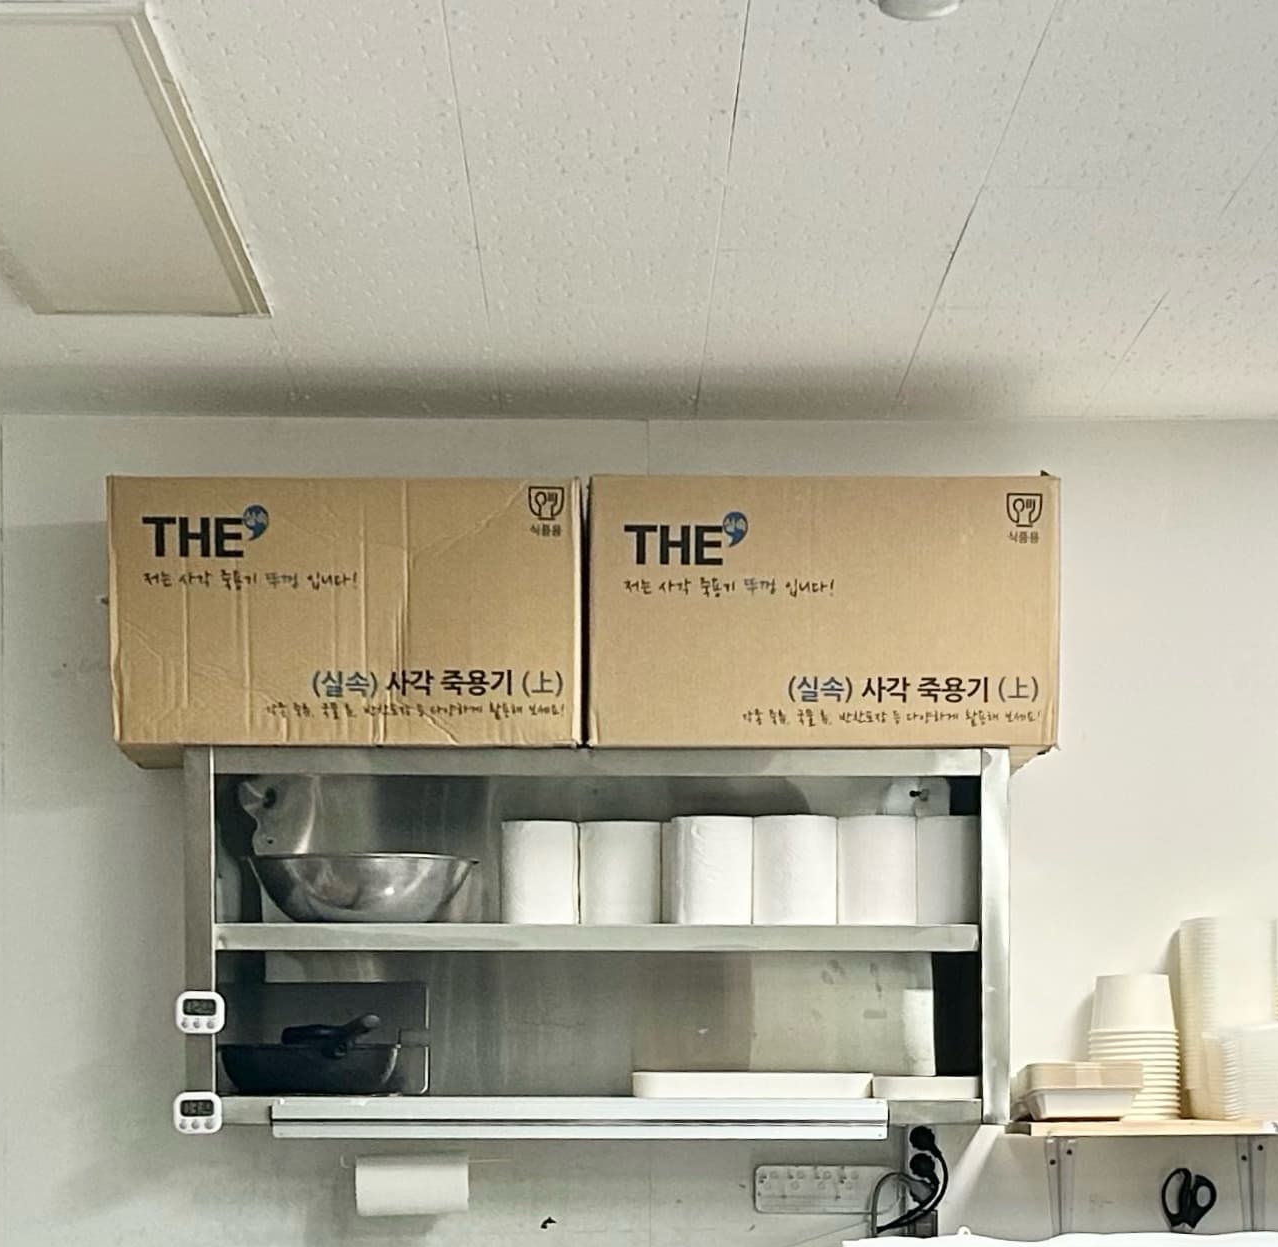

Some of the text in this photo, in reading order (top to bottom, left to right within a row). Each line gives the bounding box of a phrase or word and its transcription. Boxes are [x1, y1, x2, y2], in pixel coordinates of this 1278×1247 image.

[142, 516, 244, 557] THE
[624, 524, 723, 566] THE
[179, 571, 212, 587] 사각
[623, 578, 653, 594] 저는
[658, 578, 692, 593] 사각
[785, 578, 835, 598] 입니다!
[311, 669, 564, 698] (실속) 사각 죽용기 (上)
[788, 676, 1039, 703] (실속) 사각 죽용기 (上)
